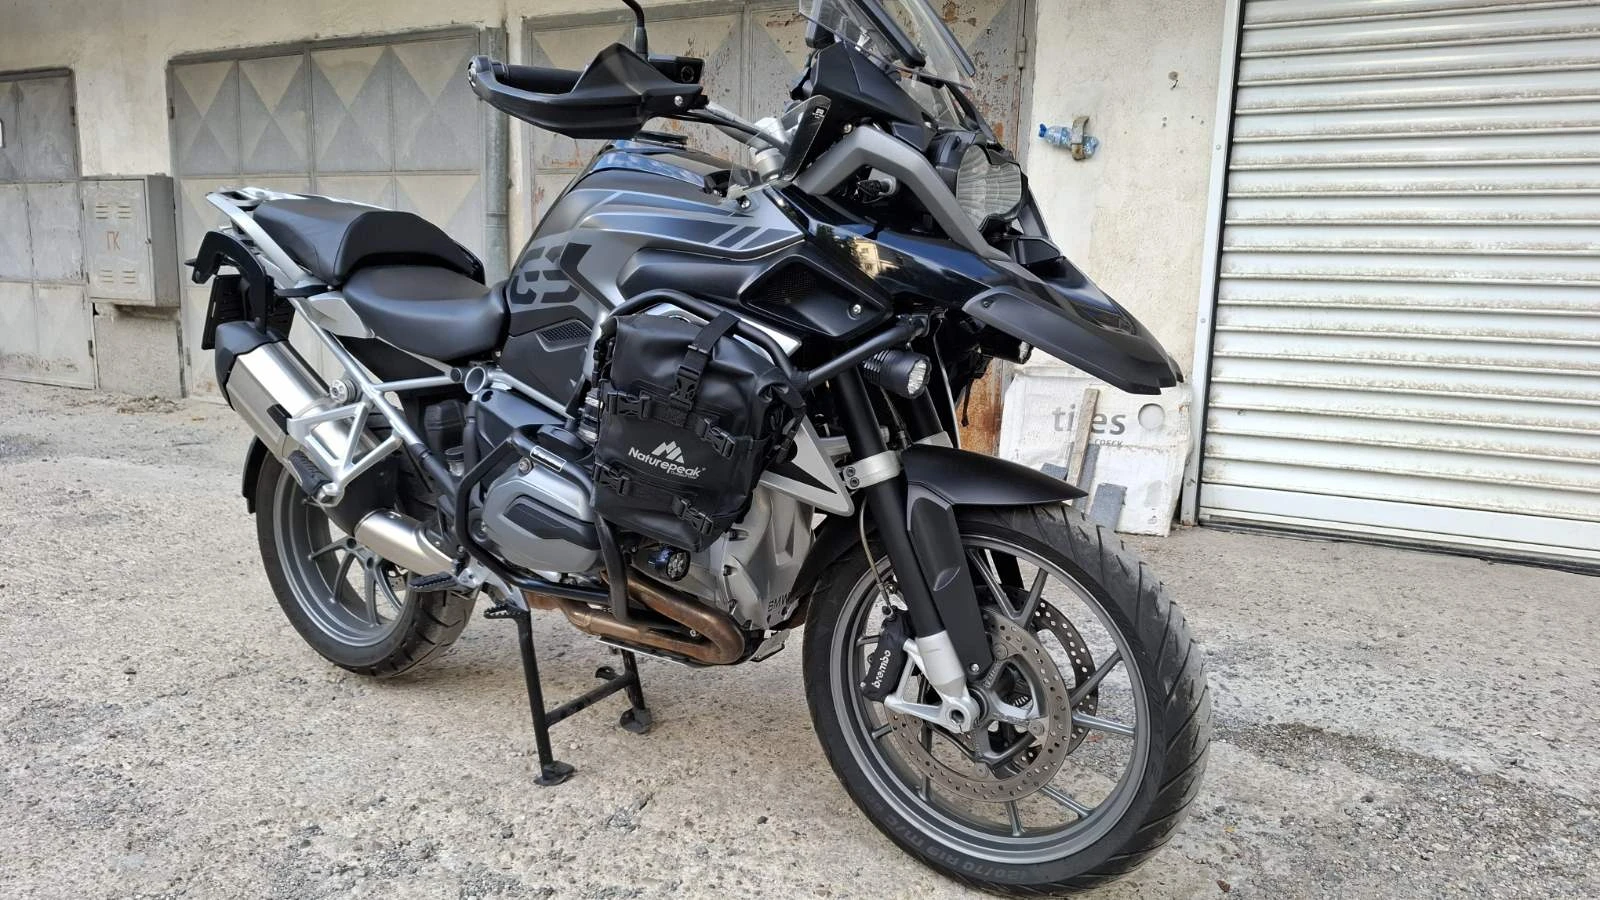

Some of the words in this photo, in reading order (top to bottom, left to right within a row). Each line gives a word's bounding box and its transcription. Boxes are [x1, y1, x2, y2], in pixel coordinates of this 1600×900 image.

[1051, 403, 1126, 435] ties
[628, 446, 702, 477] Naturepeak
[767, 592, 791, 612] BMW
[871, 649, 891, 689] brembo
